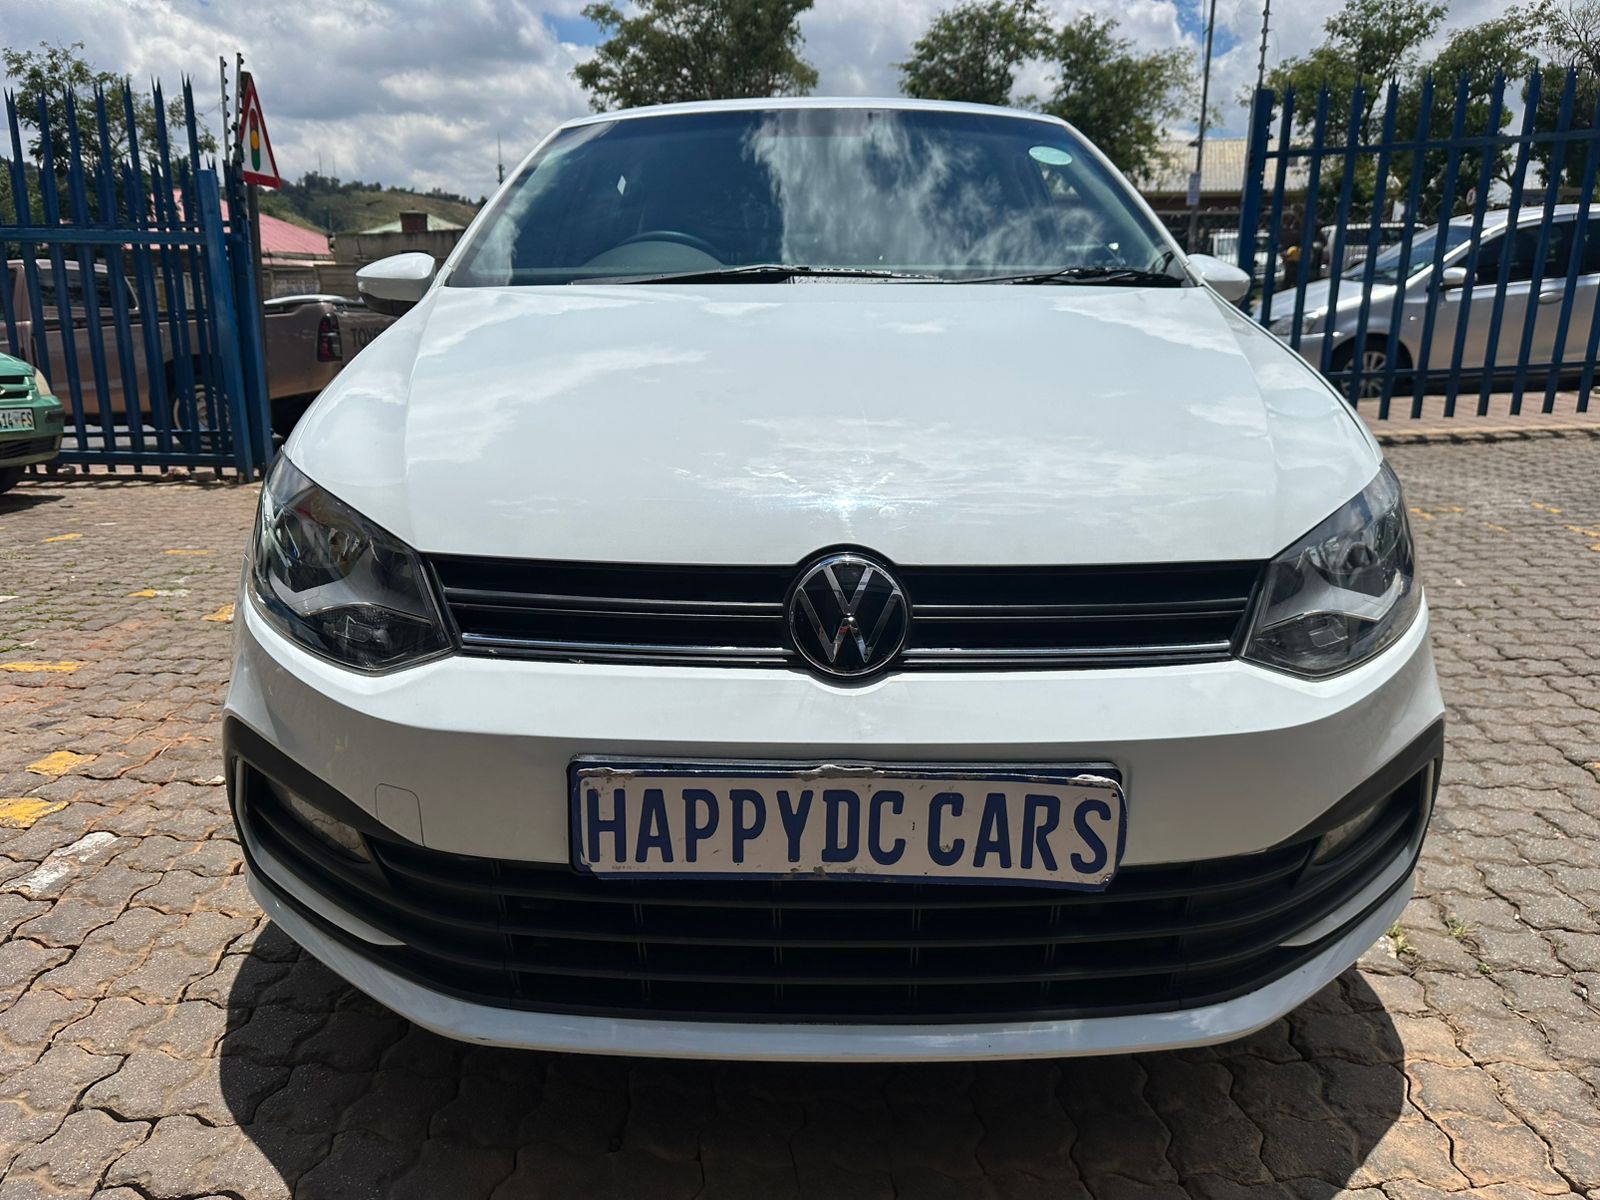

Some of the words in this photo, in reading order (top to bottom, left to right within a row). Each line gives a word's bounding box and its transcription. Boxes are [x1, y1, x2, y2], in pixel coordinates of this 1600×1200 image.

[0, 412, 13, 429] 14
[586, 788, 906, 866] HAPPYDC
[927, 792, 1112, 875] CARS
